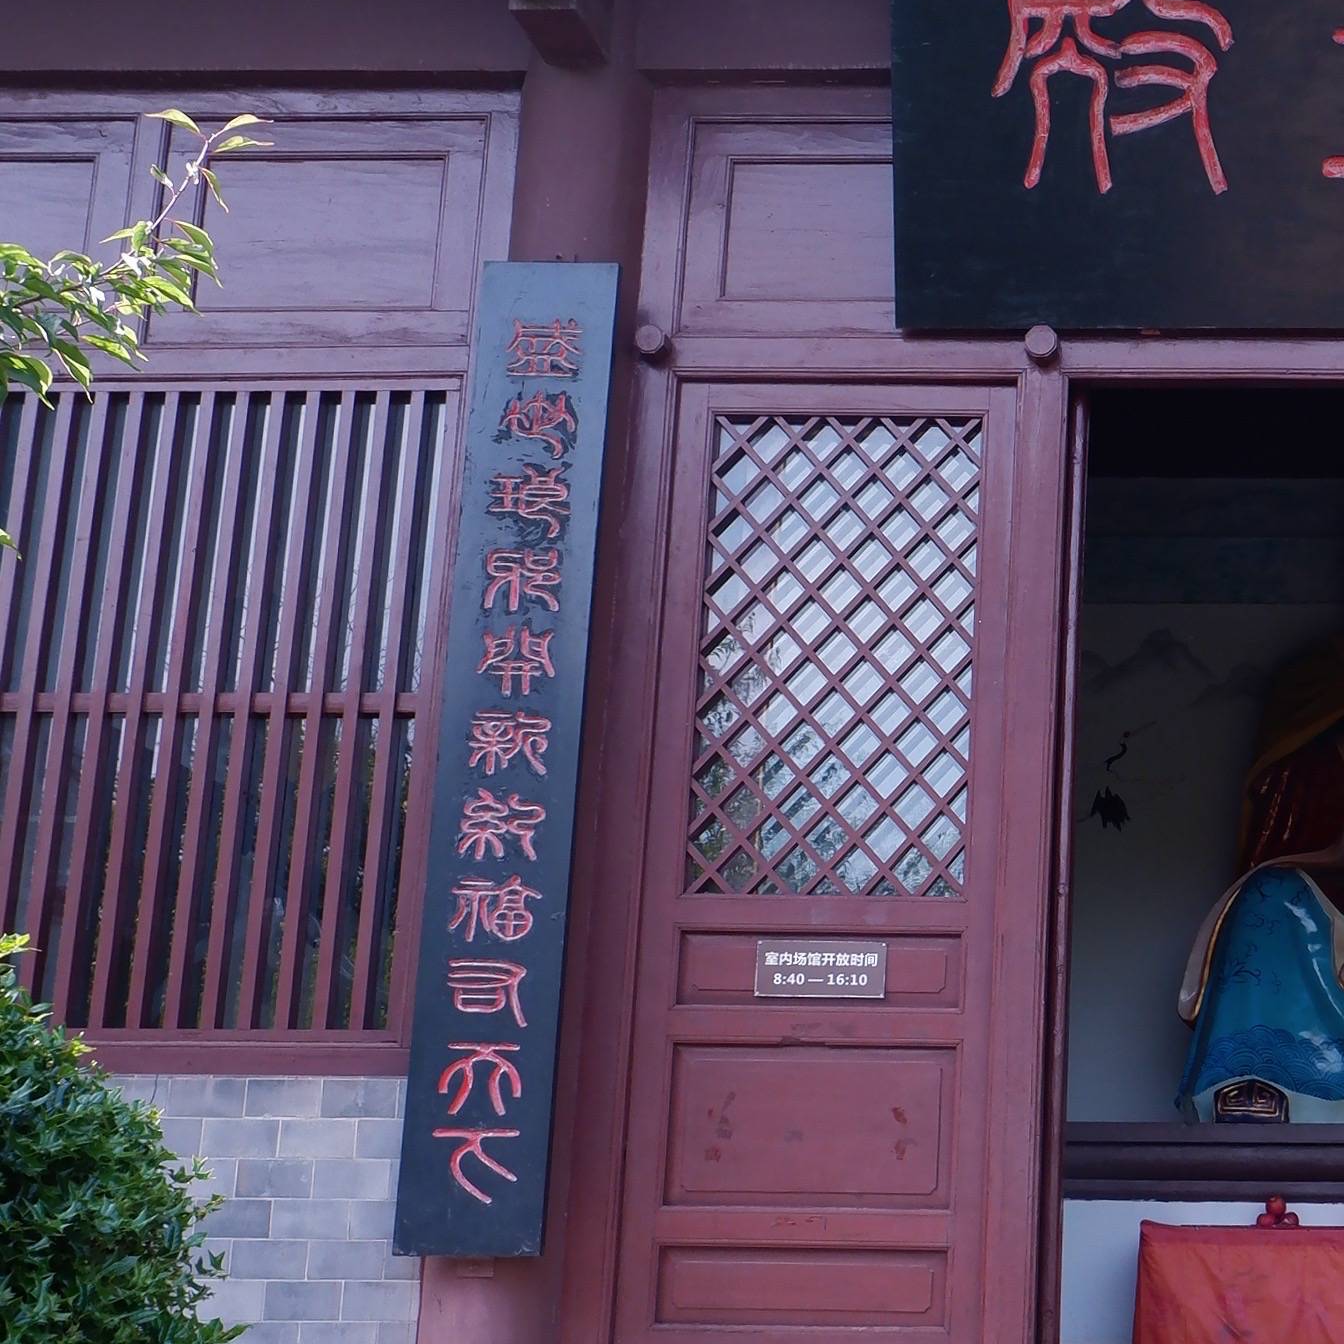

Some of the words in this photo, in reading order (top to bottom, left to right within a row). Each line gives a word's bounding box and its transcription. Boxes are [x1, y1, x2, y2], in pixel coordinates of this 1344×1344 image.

[764, 951, 878, 967] 室内场馆开放时间
[773, 973, 805, 985] 8:40
[827, 973, 868, 986] 16:10
